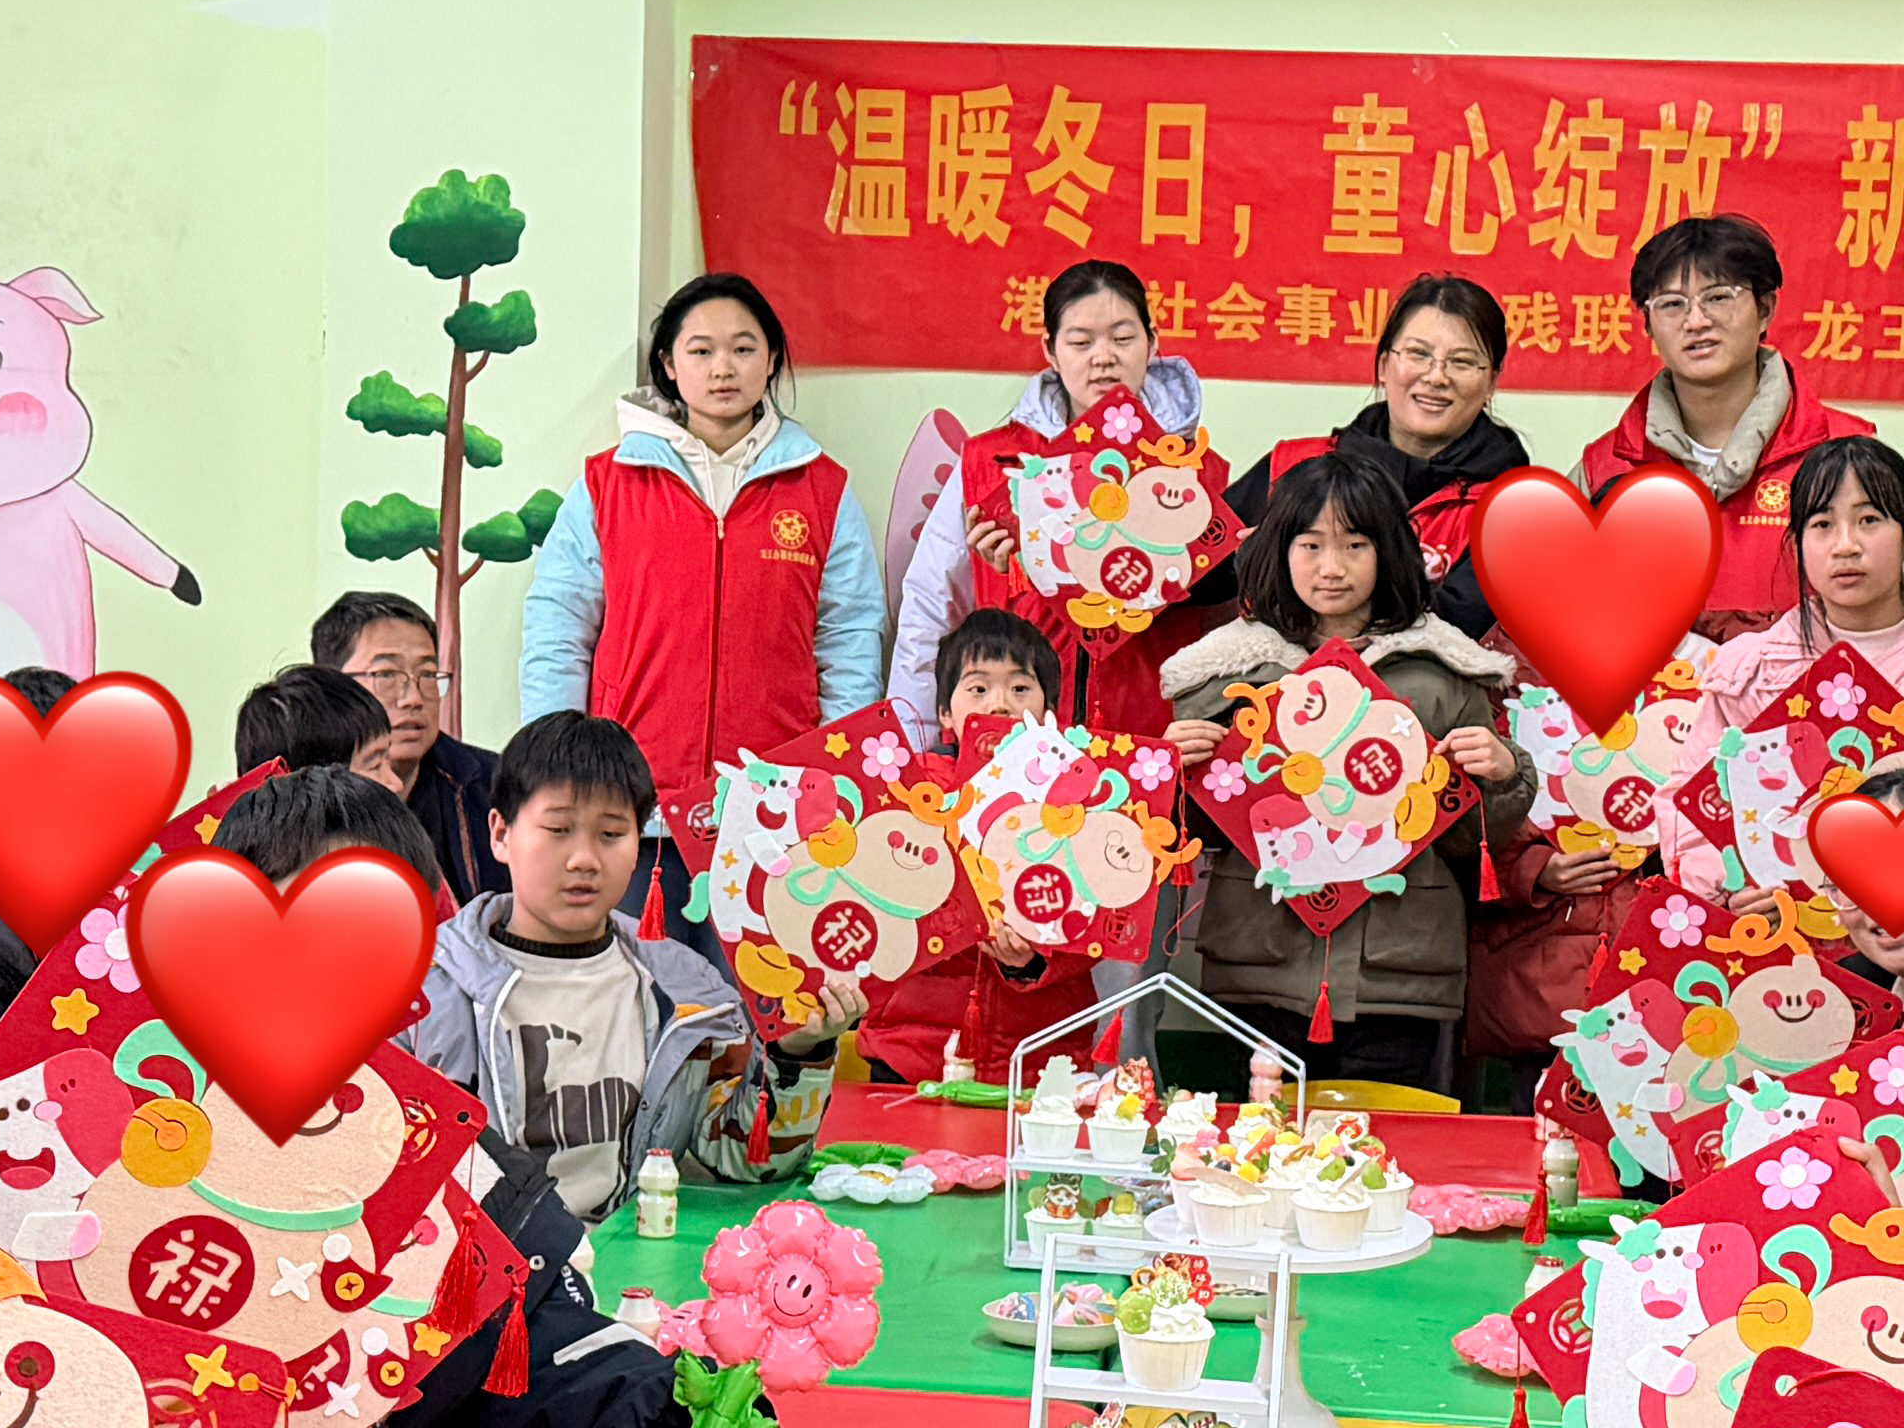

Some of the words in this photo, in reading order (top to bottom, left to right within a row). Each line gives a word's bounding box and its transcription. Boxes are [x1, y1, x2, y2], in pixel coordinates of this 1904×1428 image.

[1105, 551, 1148, 595] 禄
[1350, 743, 1398, 790] 禄
[1609, 781, 1653, 827] 禄
[1021, 871, 1064, 916] 禄
[817, 907, 873, 965] 禄
[144, 1229, 243, 1320] 禄
